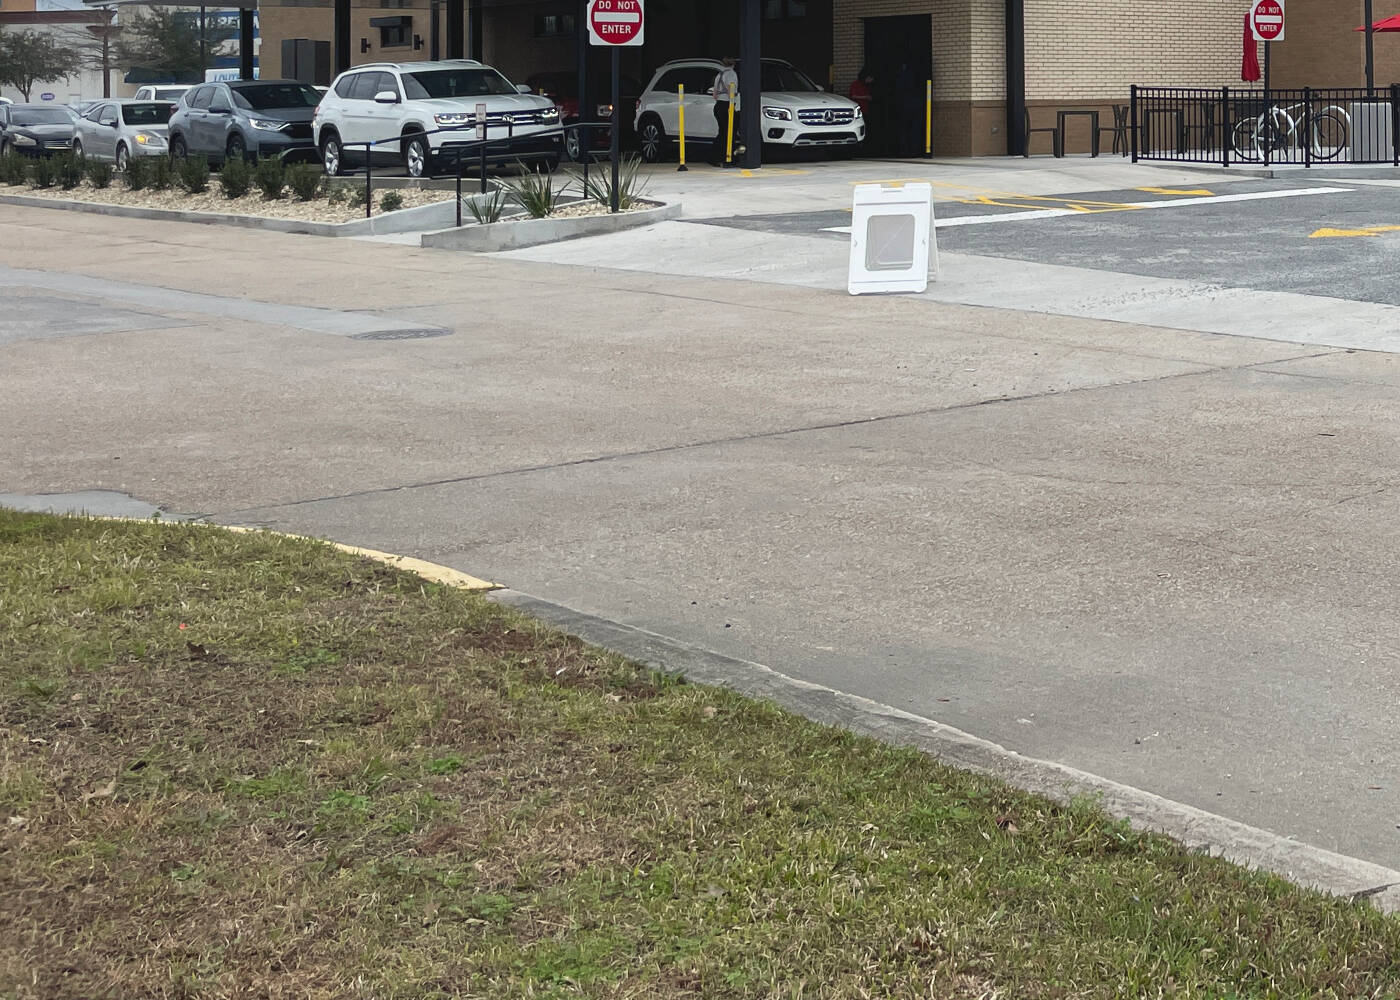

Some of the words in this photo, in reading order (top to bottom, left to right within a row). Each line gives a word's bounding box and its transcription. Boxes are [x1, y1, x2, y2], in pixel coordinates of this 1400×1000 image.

[598, 0, 611, 10] DO
[617, 1, 635, 10] NOT
[1257, 6, 1266, 14] DO
[1268, 6, 1280, 14] NOT
[601, 24, 632, 34] ENTER
[1259, 24, 1278, 32] ENTER
